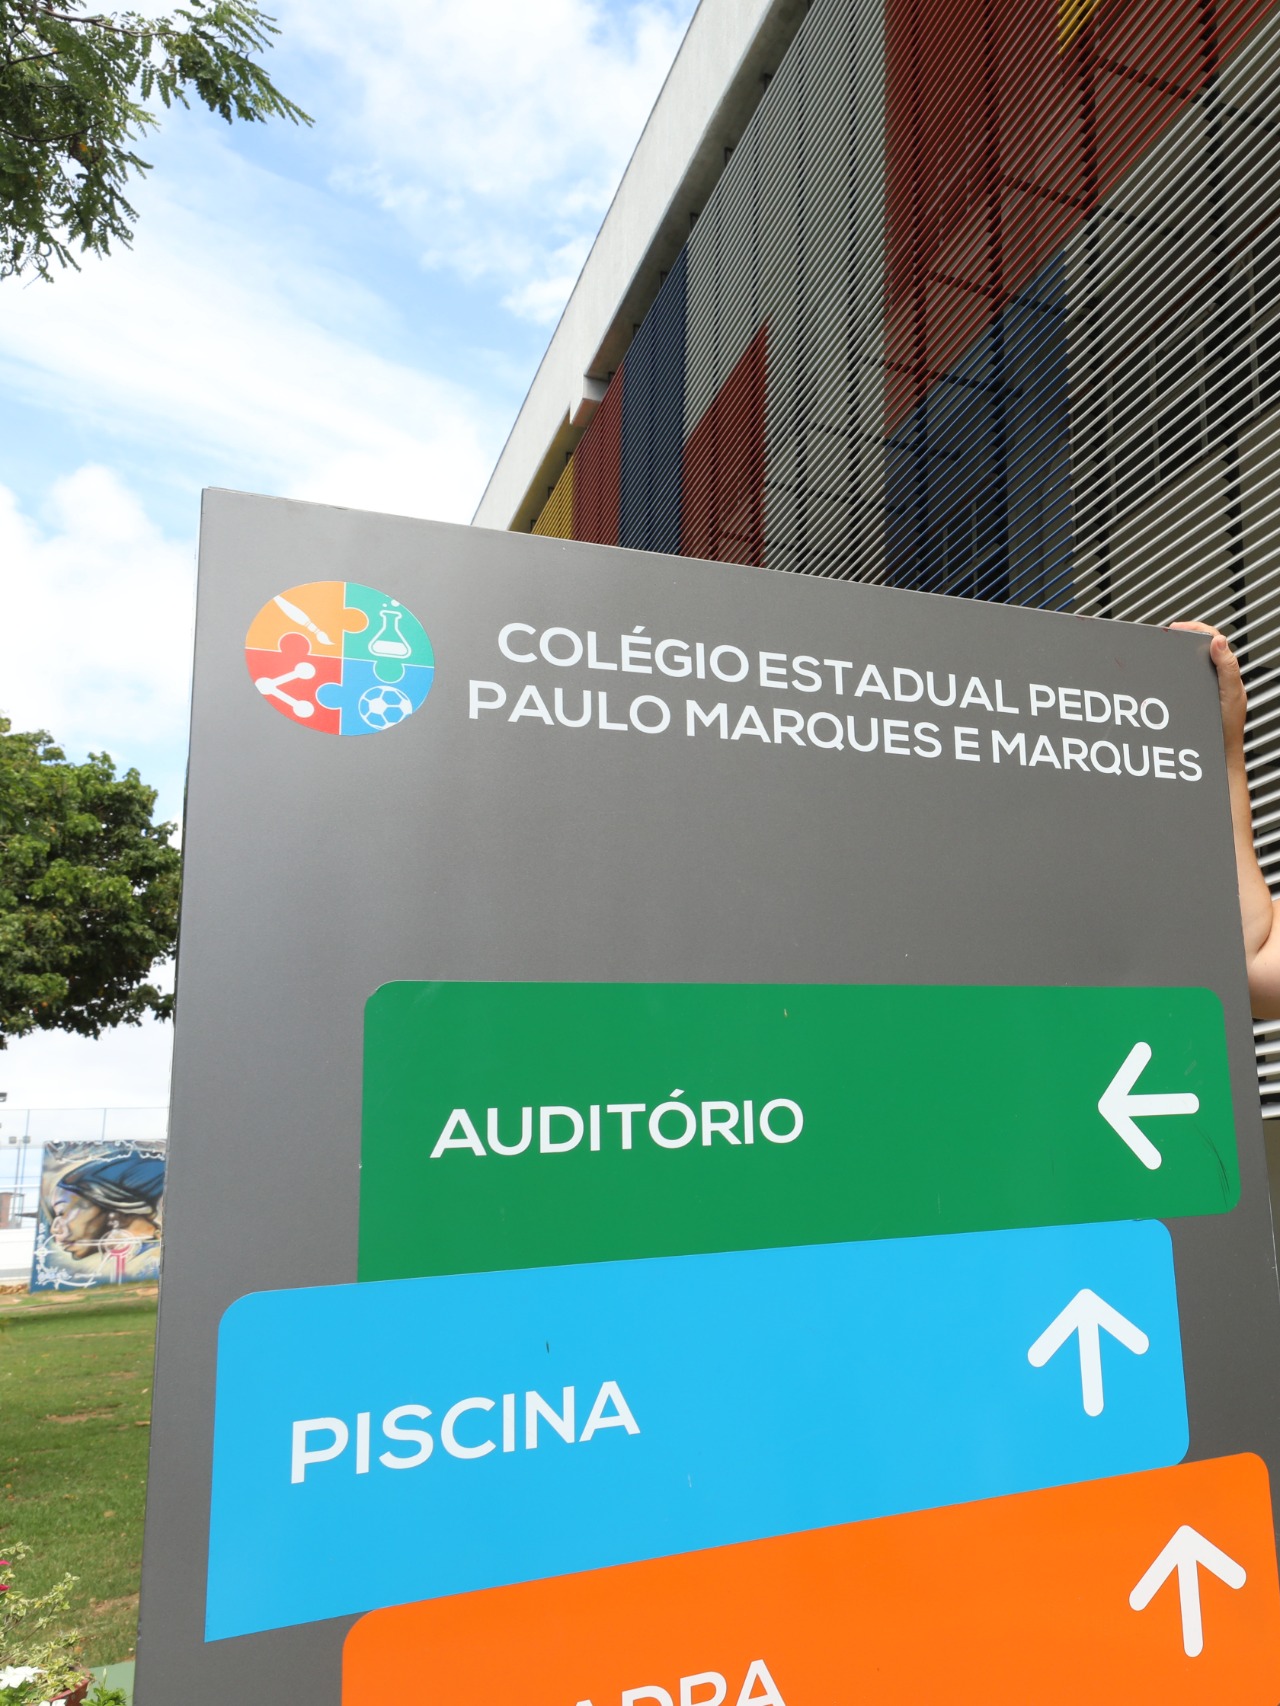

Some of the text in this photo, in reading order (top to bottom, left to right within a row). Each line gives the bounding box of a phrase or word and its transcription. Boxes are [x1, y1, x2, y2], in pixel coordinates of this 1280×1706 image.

[497, 622, 1170, 731] COLÉGIO ESTADUAL PEDRO
[468, 680, 1203, 782] PAULO MARQUES E MARQUES
[430, 1088, 804, 1159] AUDITÓRIO
[291, 1381, 640, 1484] PISCINA
